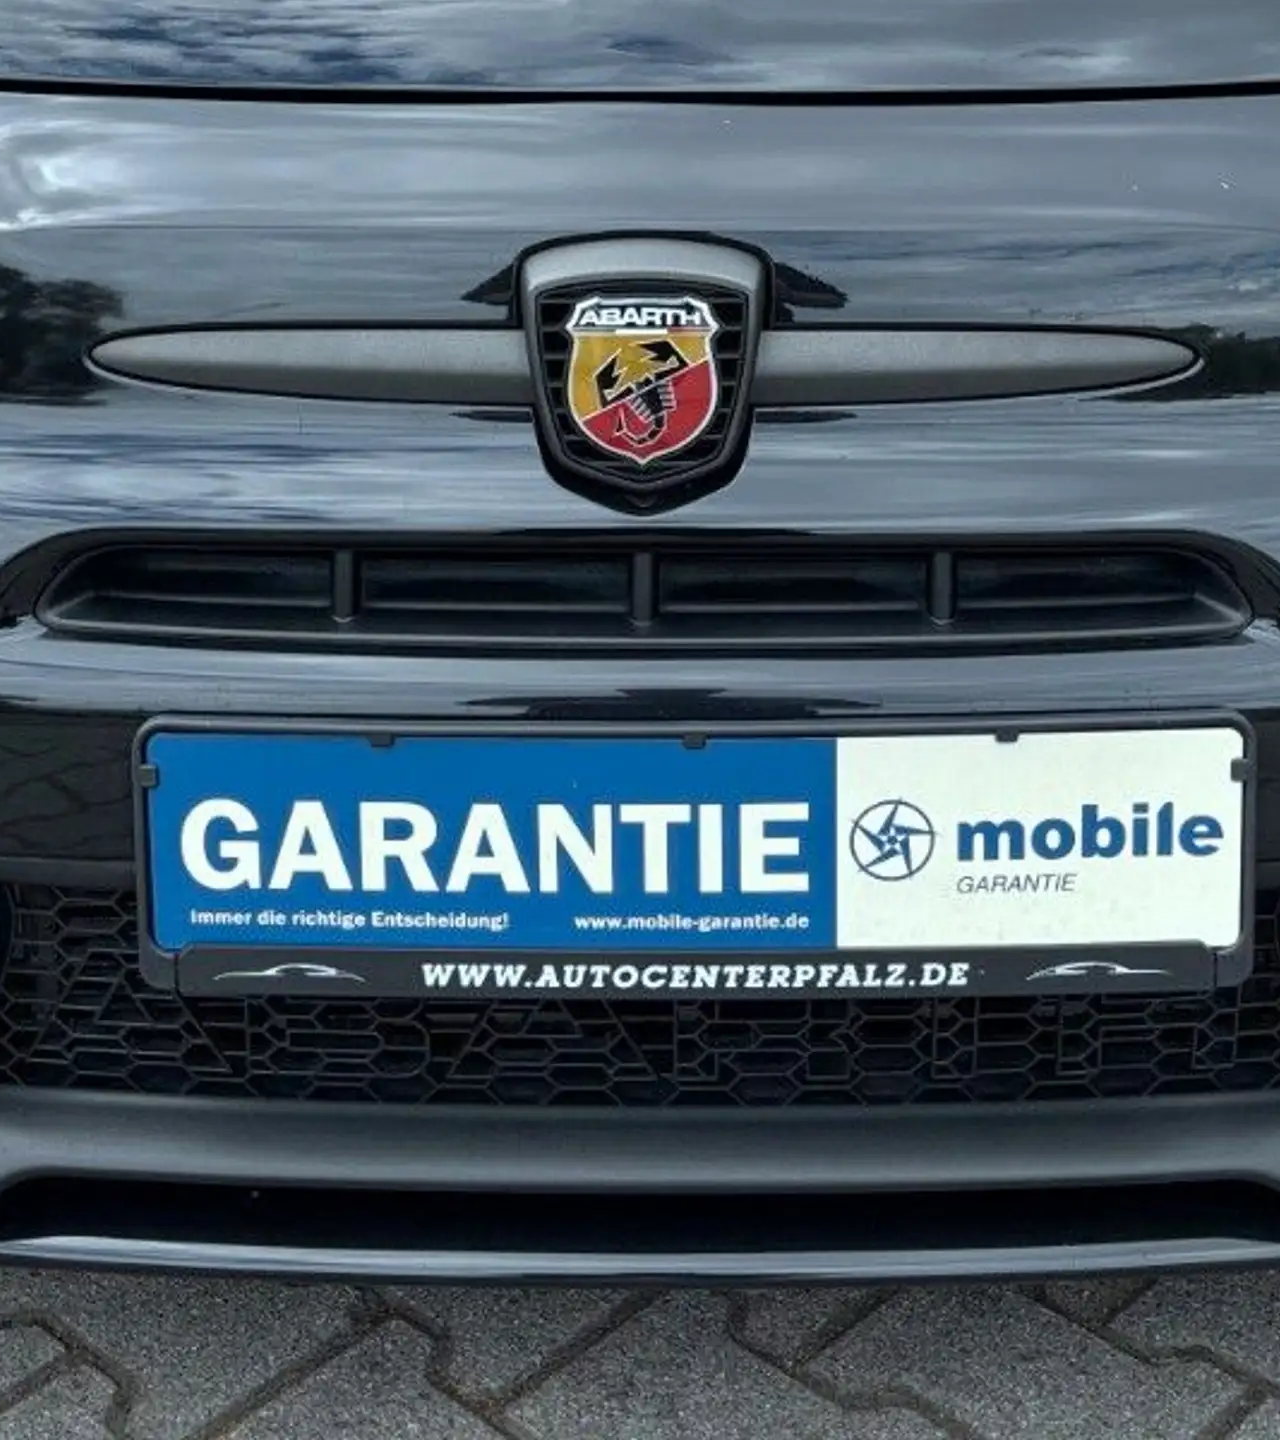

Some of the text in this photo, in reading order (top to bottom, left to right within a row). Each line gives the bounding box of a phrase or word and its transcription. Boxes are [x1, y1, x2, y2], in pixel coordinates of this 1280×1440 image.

[579, 307, 702, 327] ABARTH
[956, 801, 1224, 862] mobile
[180, 797, 811, 894] GARANTIE
[956, 872, 1078, 894] GARANTIE
[190, 908, 510, 932] Immer die richtige Entscheidung!
[574, 912, 811, 932] www.mobile-garantie.de
[421, 962, 970, 989] WWW.AUTOCENTERPFALZ.DE
